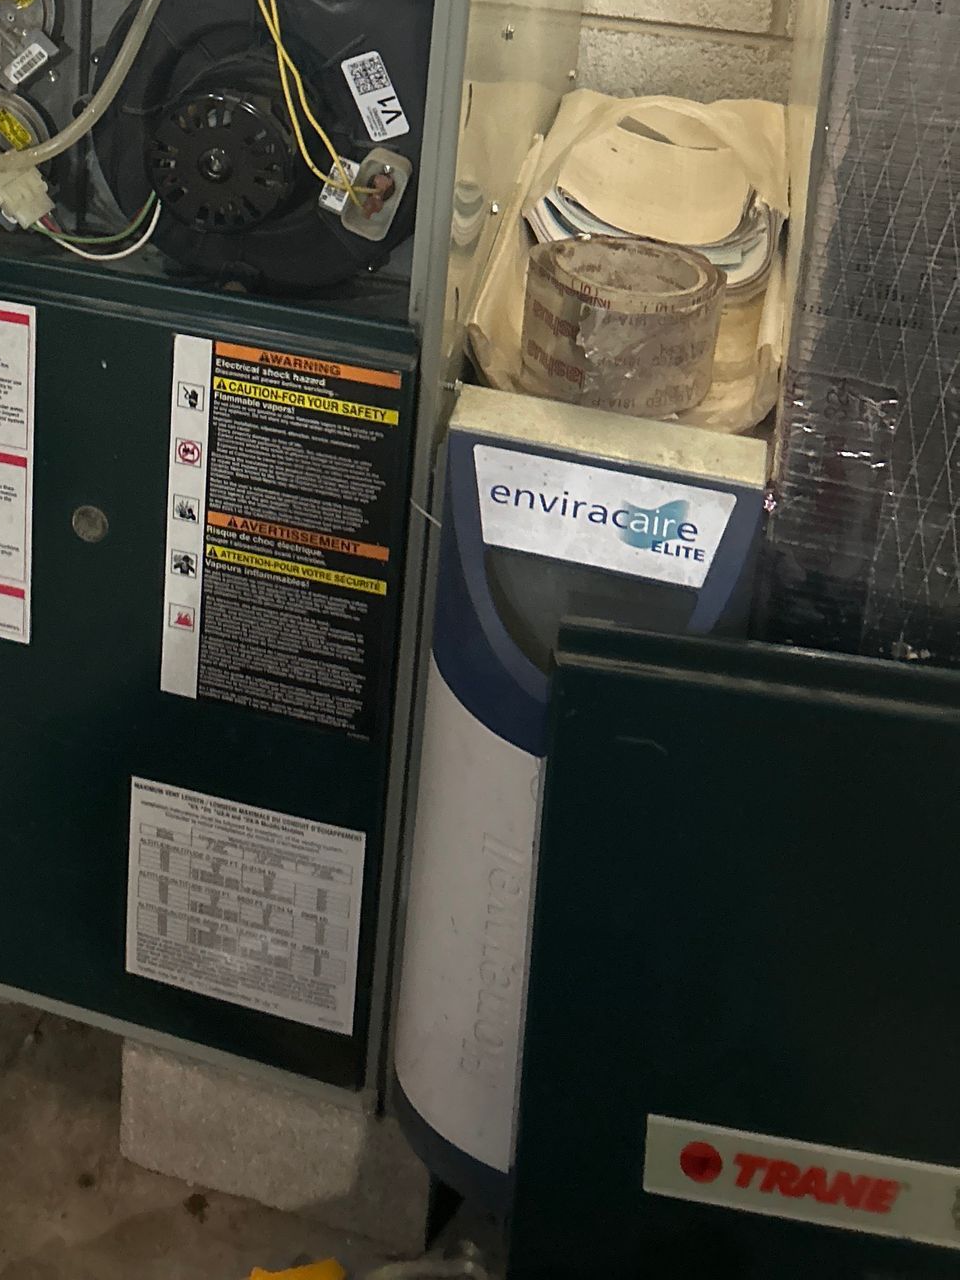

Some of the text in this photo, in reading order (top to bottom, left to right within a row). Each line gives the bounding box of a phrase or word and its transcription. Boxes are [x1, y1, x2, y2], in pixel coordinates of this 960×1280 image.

[377, 95, 403, 125] V1
[215, 358, 325, 387] Electrical shock hazard
[268, 353, 341, 376] WARNING
[214, 391, 260, 407] Flammable
[228, 381, 386, 421] CAUTION-FOR YOUR SAFETY
[489, 483, 699, 543] enviracaire
[206, 525, 237, 540] Risque
[239, 532, 250, 541] de
[252, 535, 274, 546] choc
[240, 519, 360, 554] AVERTISSEMENT
[205, 558, 241, 574] Vapeurs
[220, 549, 299, 574] ATTENTION-POUR
[301, 567, 331, 581] VOTRE
[651, 541, 706, 562] ELITE
[732, 1153, 901, 1215] TRANE
